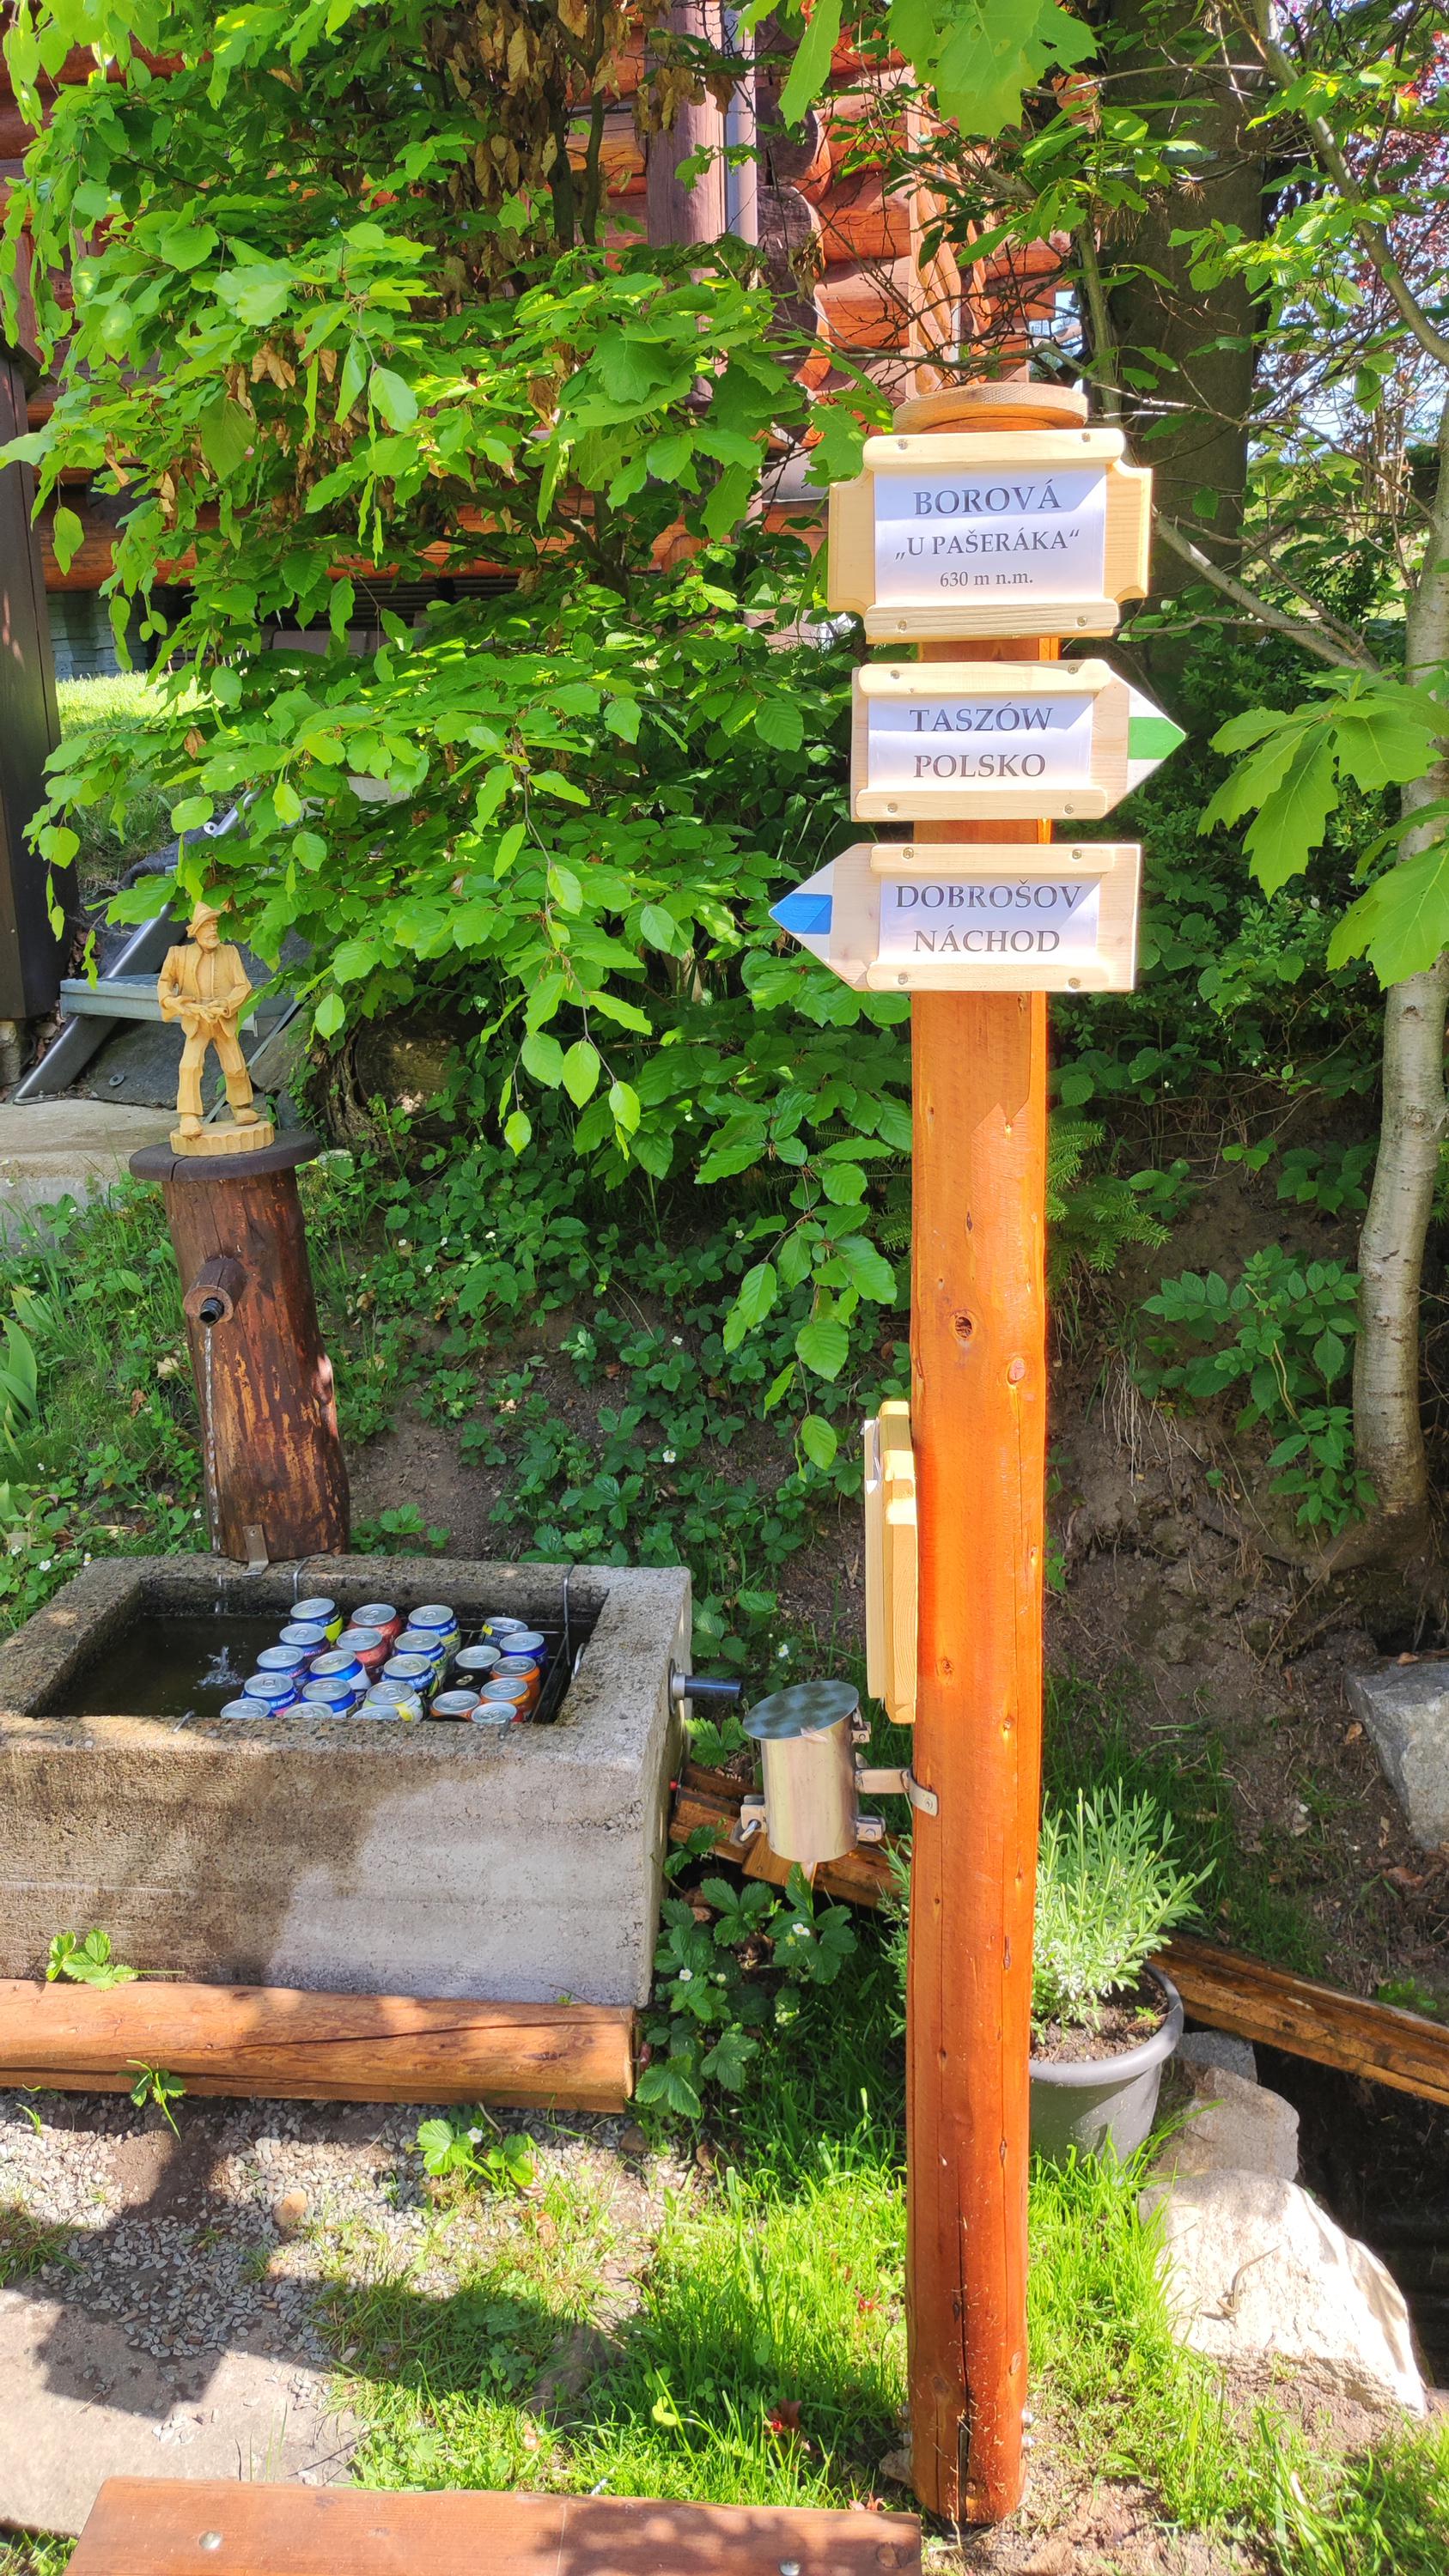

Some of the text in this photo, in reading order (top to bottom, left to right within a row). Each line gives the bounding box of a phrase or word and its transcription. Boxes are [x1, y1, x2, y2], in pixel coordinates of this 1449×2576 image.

[913, 478, 1062, 515] BOROVÁ
[940, 571, 1033, 587] 630 m n.m.
[909, 702, 1054, 732] TASZÓW
[913, 753, 1046, 778] POLSKO
[895, 878, 1082, 908] DOBROŠOV
[913, 924, 1060, 953] NÁCHOD
